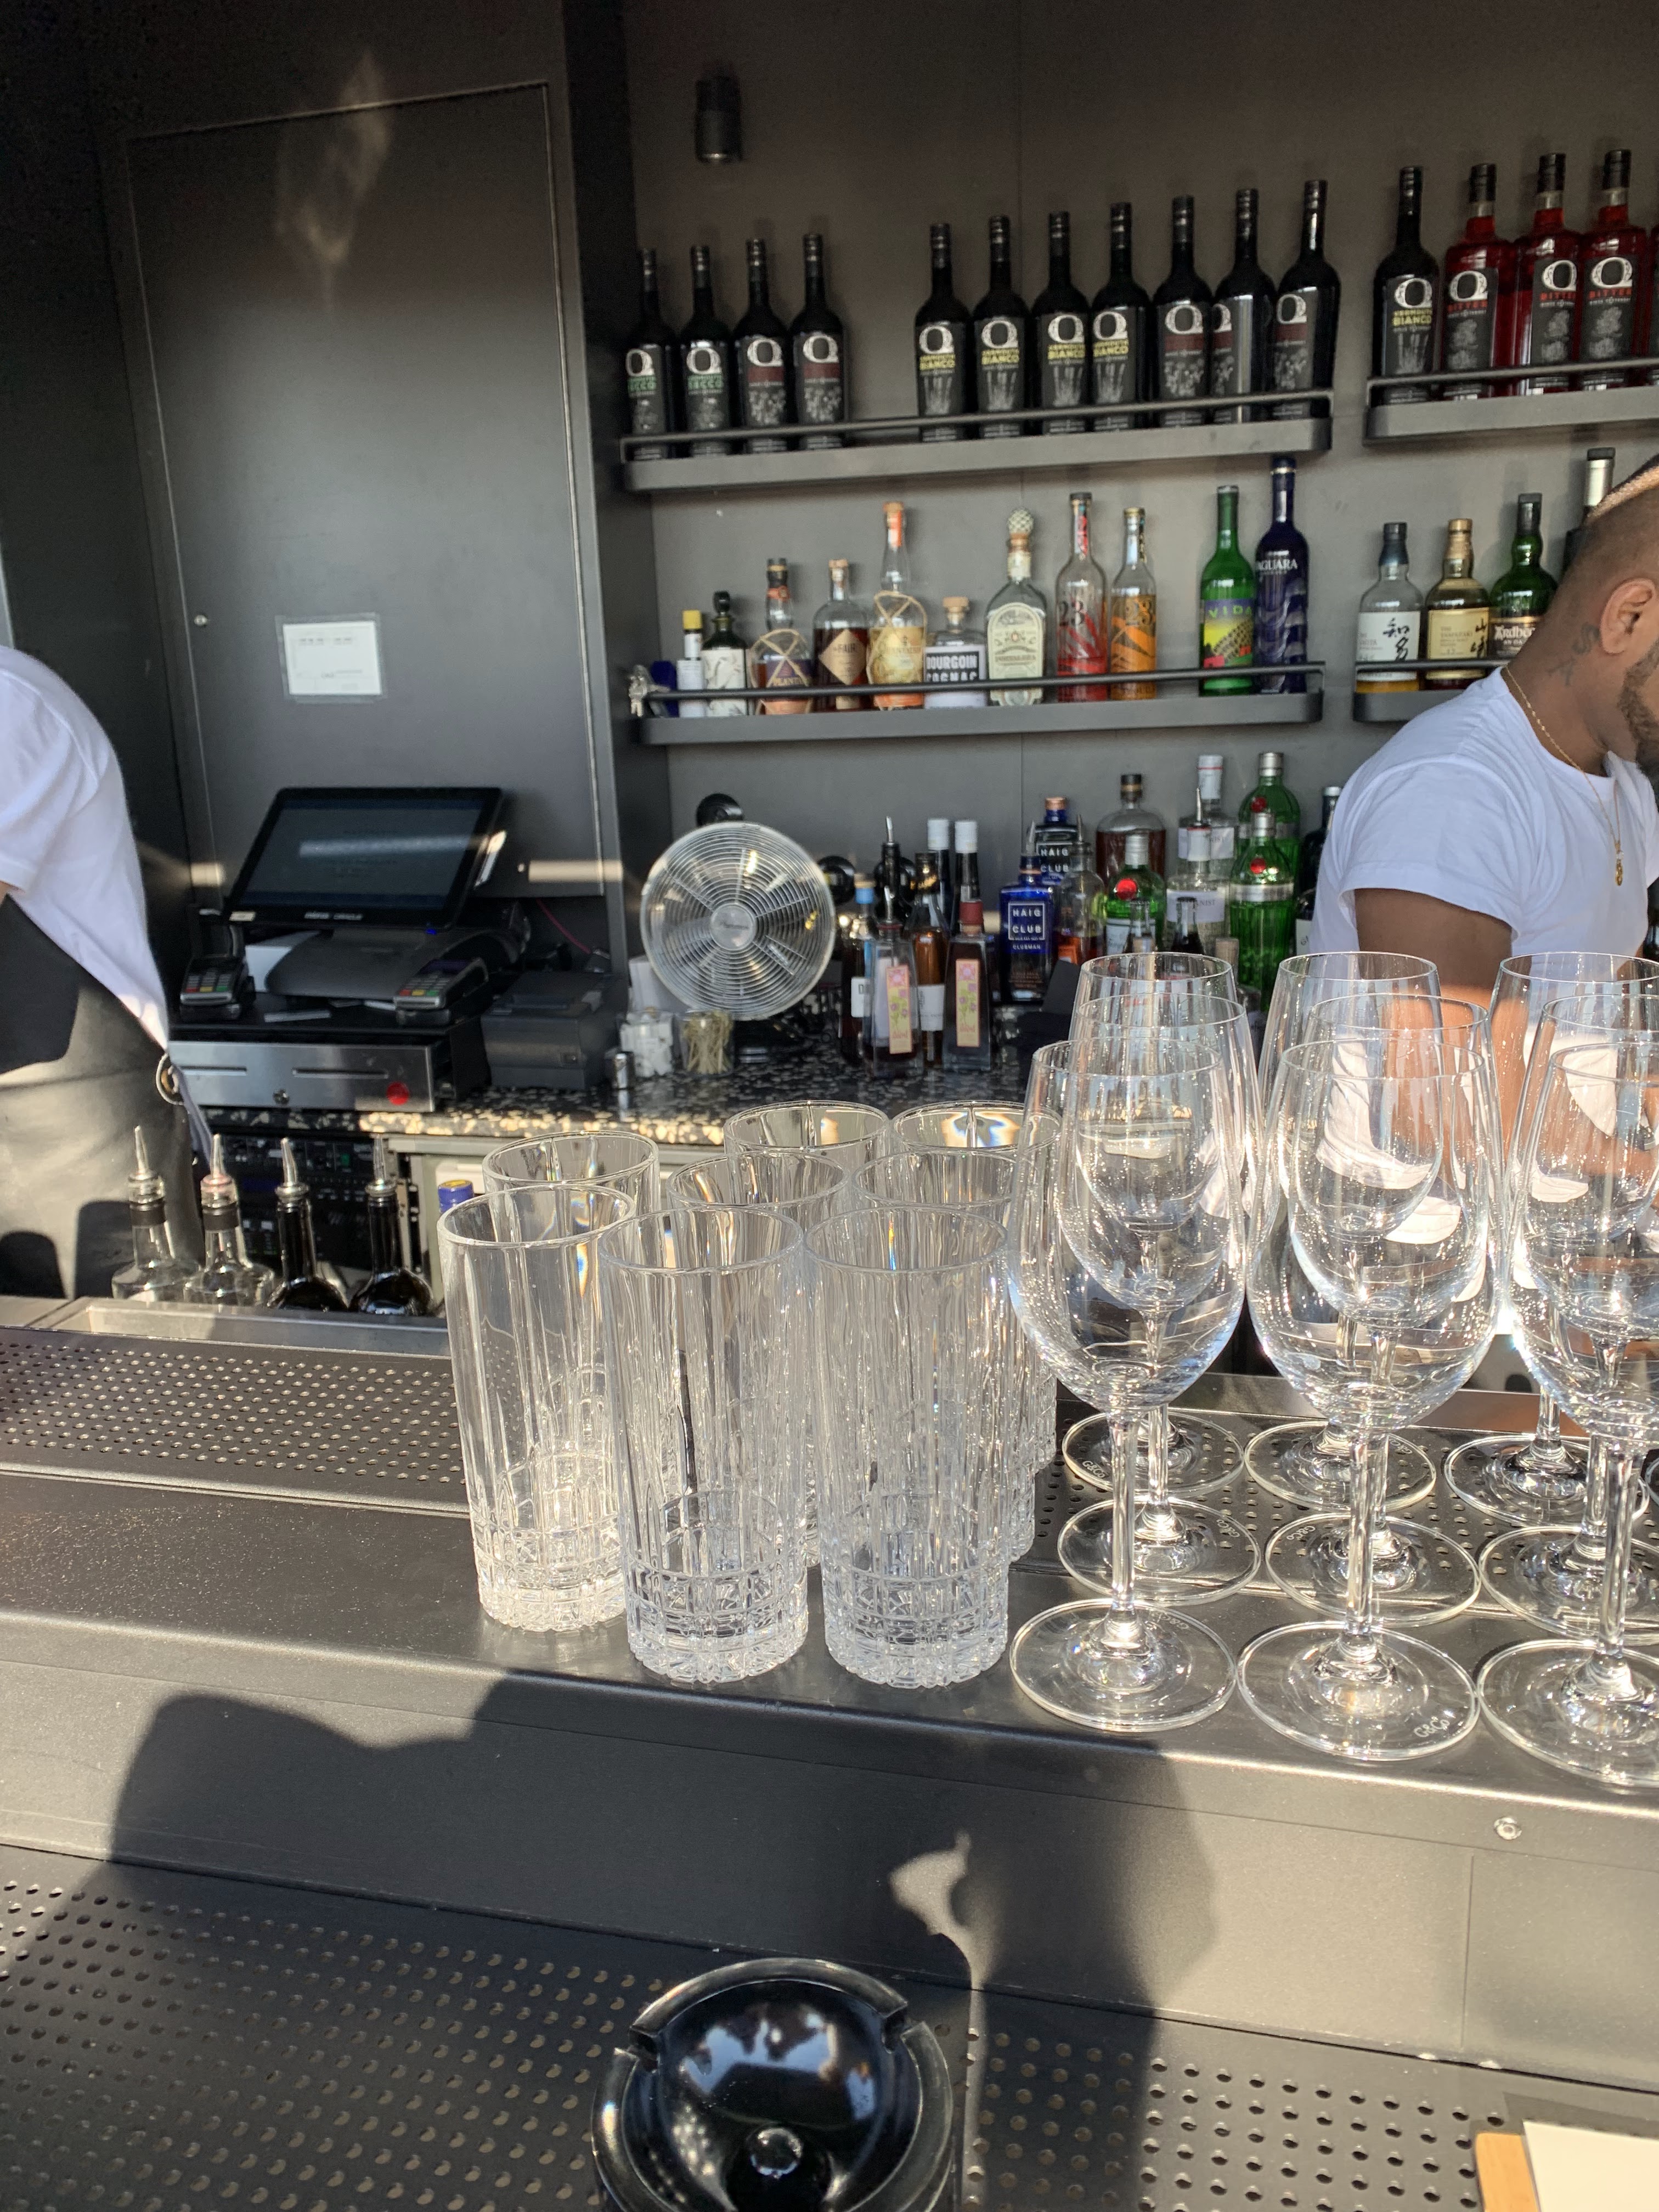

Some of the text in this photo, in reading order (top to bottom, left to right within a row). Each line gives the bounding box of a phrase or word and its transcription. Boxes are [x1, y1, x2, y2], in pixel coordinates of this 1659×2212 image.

[1449, 270, 1488, 302] Q
[1542, 260, 1577, 291] Q
[1591, 257, 1633, 289] Q
[1395, 278, 1432, 308] Q
[1589, 287, 1632, 300] BITTER
[1165, 305, 1204, 335] Q
[1277, 294, 1307, 325] Q
[919, 326, 955, 354] Q
[981, 320, 1019, 349] Q
[1048, 315, 1085, 343] Q
[1093, 312, 1128, 341] Q
[625, 348, 655, 377] Q
[686, 348, 723, 375] Q
[747, 338, 783, 366] Q
[803, 335, 839, 363] Q
[1256, 559, 1298, 570] AGUARA
[1208, 605, 1252, 618] VIDA
[1040, 848, 1069, 856] HAIG
[1040, 864, 1069, 873] CLUB
[1012, 908, 1041, 917] HAIG
[1012, 924, 1042, 934] CLUB
[1082, 1460, 1105, 1478] G&Co
[1216, 1519, 1240, 1537] G&Co
[1286, 1525, 1316, 1541] G&Co
[1158, 1615, 1190, 1629] G&C
[1413, 1718, 1451, 1738] G&Co
